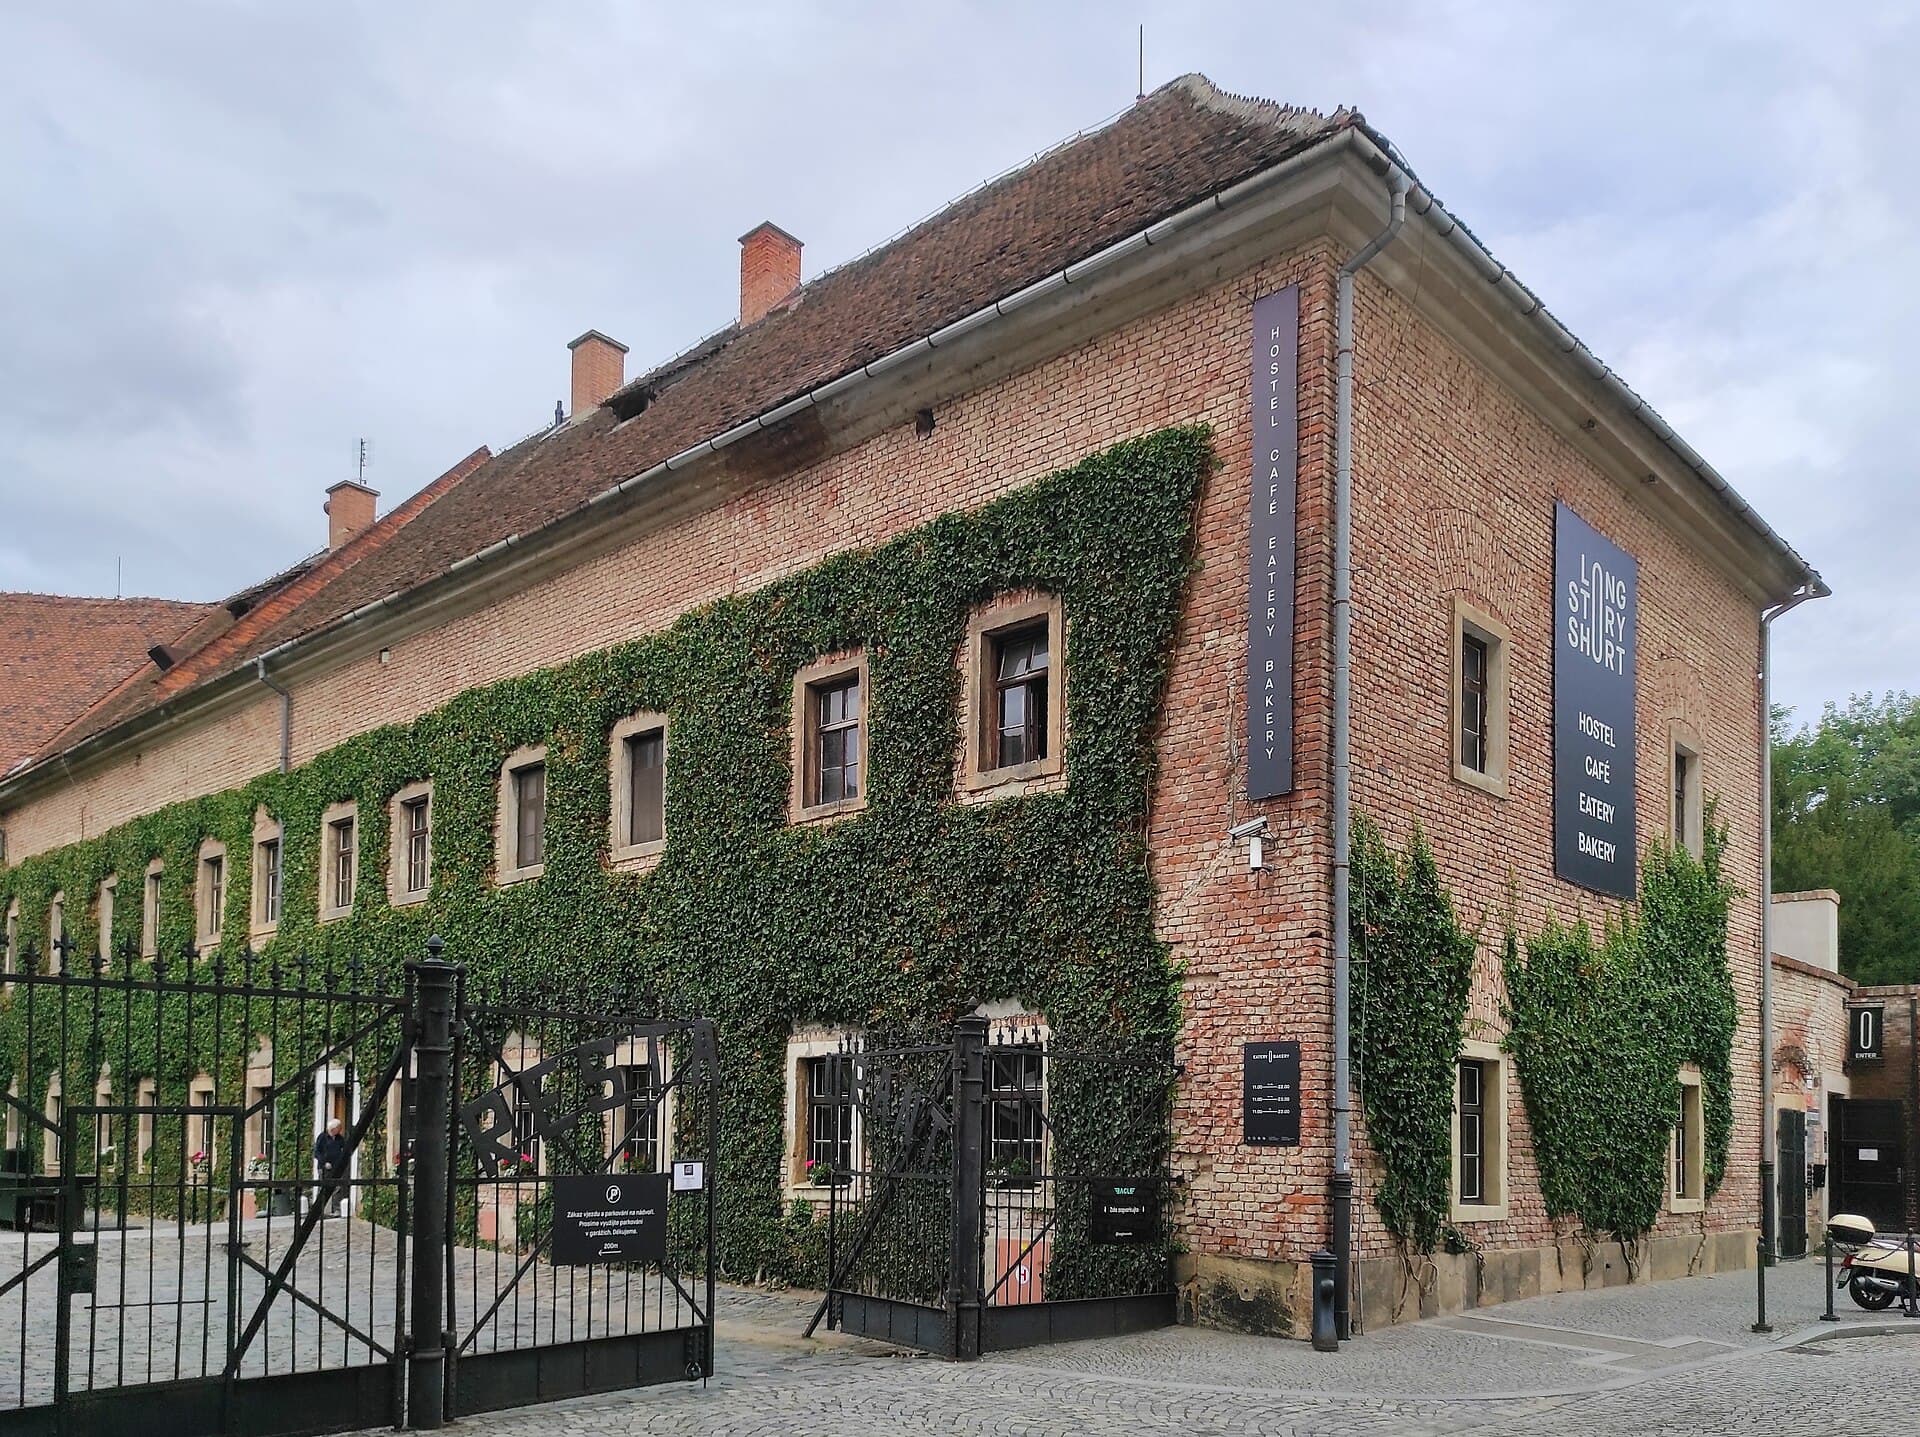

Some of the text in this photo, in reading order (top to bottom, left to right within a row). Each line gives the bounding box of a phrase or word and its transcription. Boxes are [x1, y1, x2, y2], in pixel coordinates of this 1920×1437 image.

[1264, 326, 1280, 760] HOSTEL CAFÉ EATERY BAKERY
[1579, 711, 1616, 749] HOSTEL
[1585, 756, 1610, 785] CAFÉ
[1579, 791, 1615, 825] EATERY
[1578, 831, 1616, 864] BAKERY
